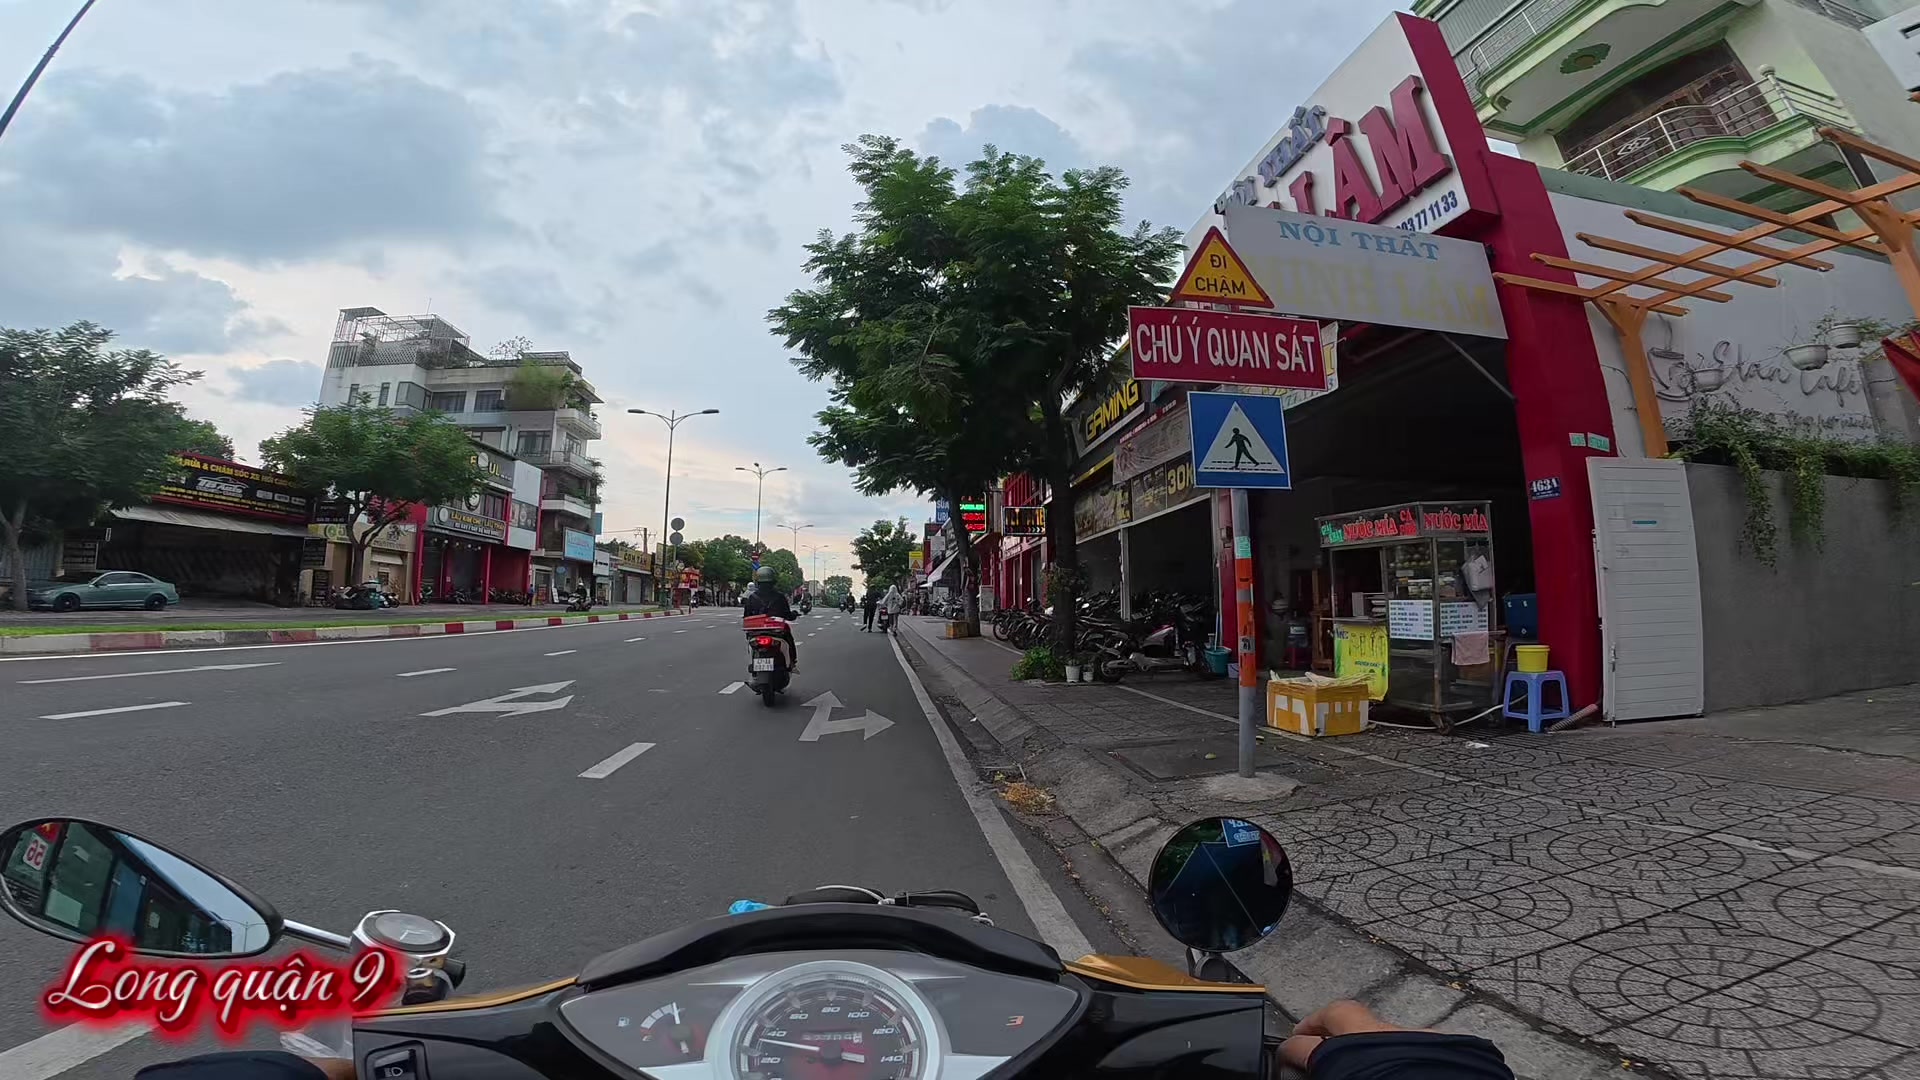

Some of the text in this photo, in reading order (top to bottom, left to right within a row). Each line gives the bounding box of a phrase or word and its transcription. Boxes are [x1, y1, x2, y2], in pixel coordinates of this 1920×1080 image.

[1441, 190, 1458, 213] 33
[1277, 219, 1439, 261] NỘI THẤT
[1209, 253, 1227, 269] ĐI
[1194, 275, 1246, 297] CHẬM
[1135, 315, 1315, 374] CHÚ Ý QUAN SÁT
[1085, 378, 1139, 442] GAMING
[1530, 478, 1559, 493] 463A
[1424, 506, 1489, 531] NƯỚC MÍA
[872, 1027, 895, 1035] 120
[880, 1055, 904, 1063] 140
